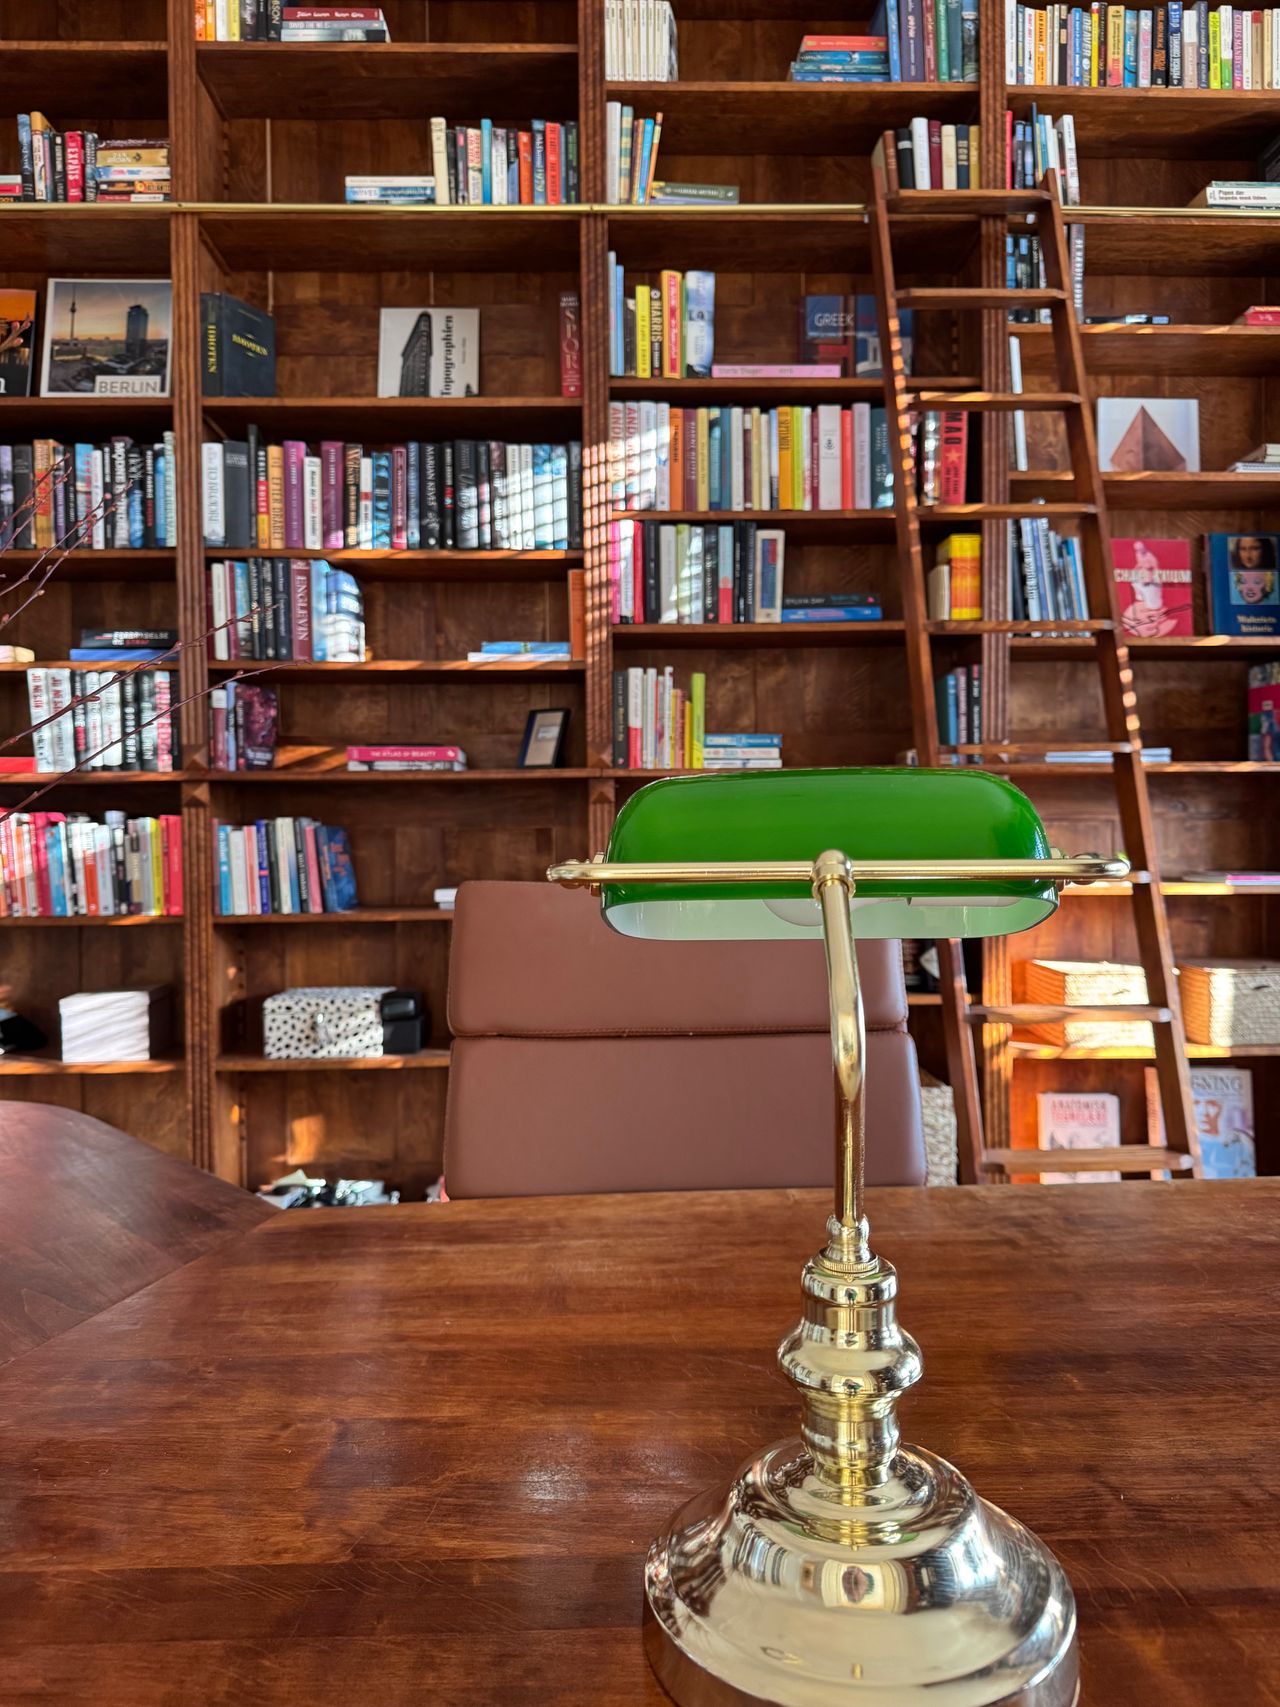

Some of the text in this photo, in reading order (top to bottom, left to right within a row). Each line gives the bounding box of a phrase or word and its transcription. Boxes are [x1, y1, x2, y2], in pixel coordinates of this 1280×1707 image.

[1083, 19, 1091, 56] DEAVER
[67, 148, 79, 180] EXPATS
[651, 304, 662, 342] HARRIS
[814, 312, 855, 327] GREEK
[208, 325, 217, 373] IDIOTEN
[441, 315, 456, 395] Topographien
[99, 380, 157, 394] BERLIN
[944, 412, 962, 445] MAO
[426, 446, 437, 506] MARIAN KEYES
